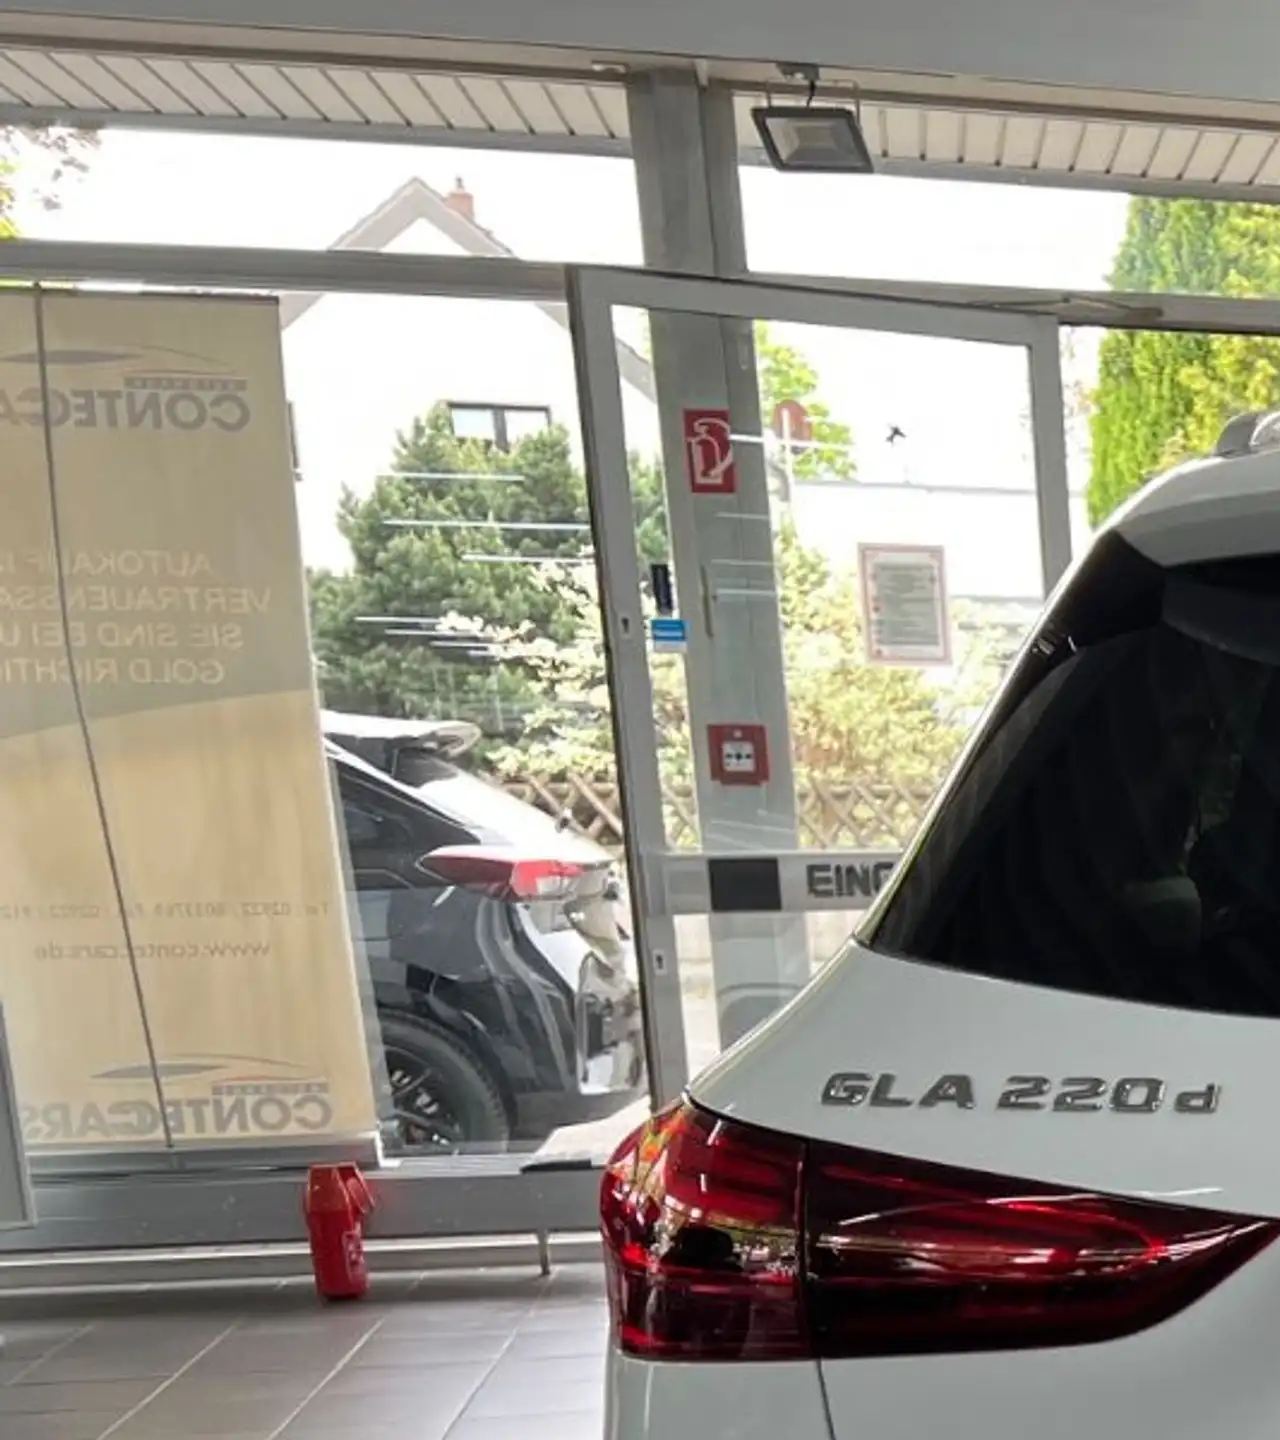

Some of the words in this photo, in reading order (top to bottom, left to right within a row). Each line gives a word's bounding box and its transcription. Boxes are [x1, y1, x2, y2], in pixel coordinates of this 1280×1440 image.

[820, 1072, 977, 1109] GLA
[996, 1075, 1166, 1113] 220
[1173, 1083, 1219, 1114] d
